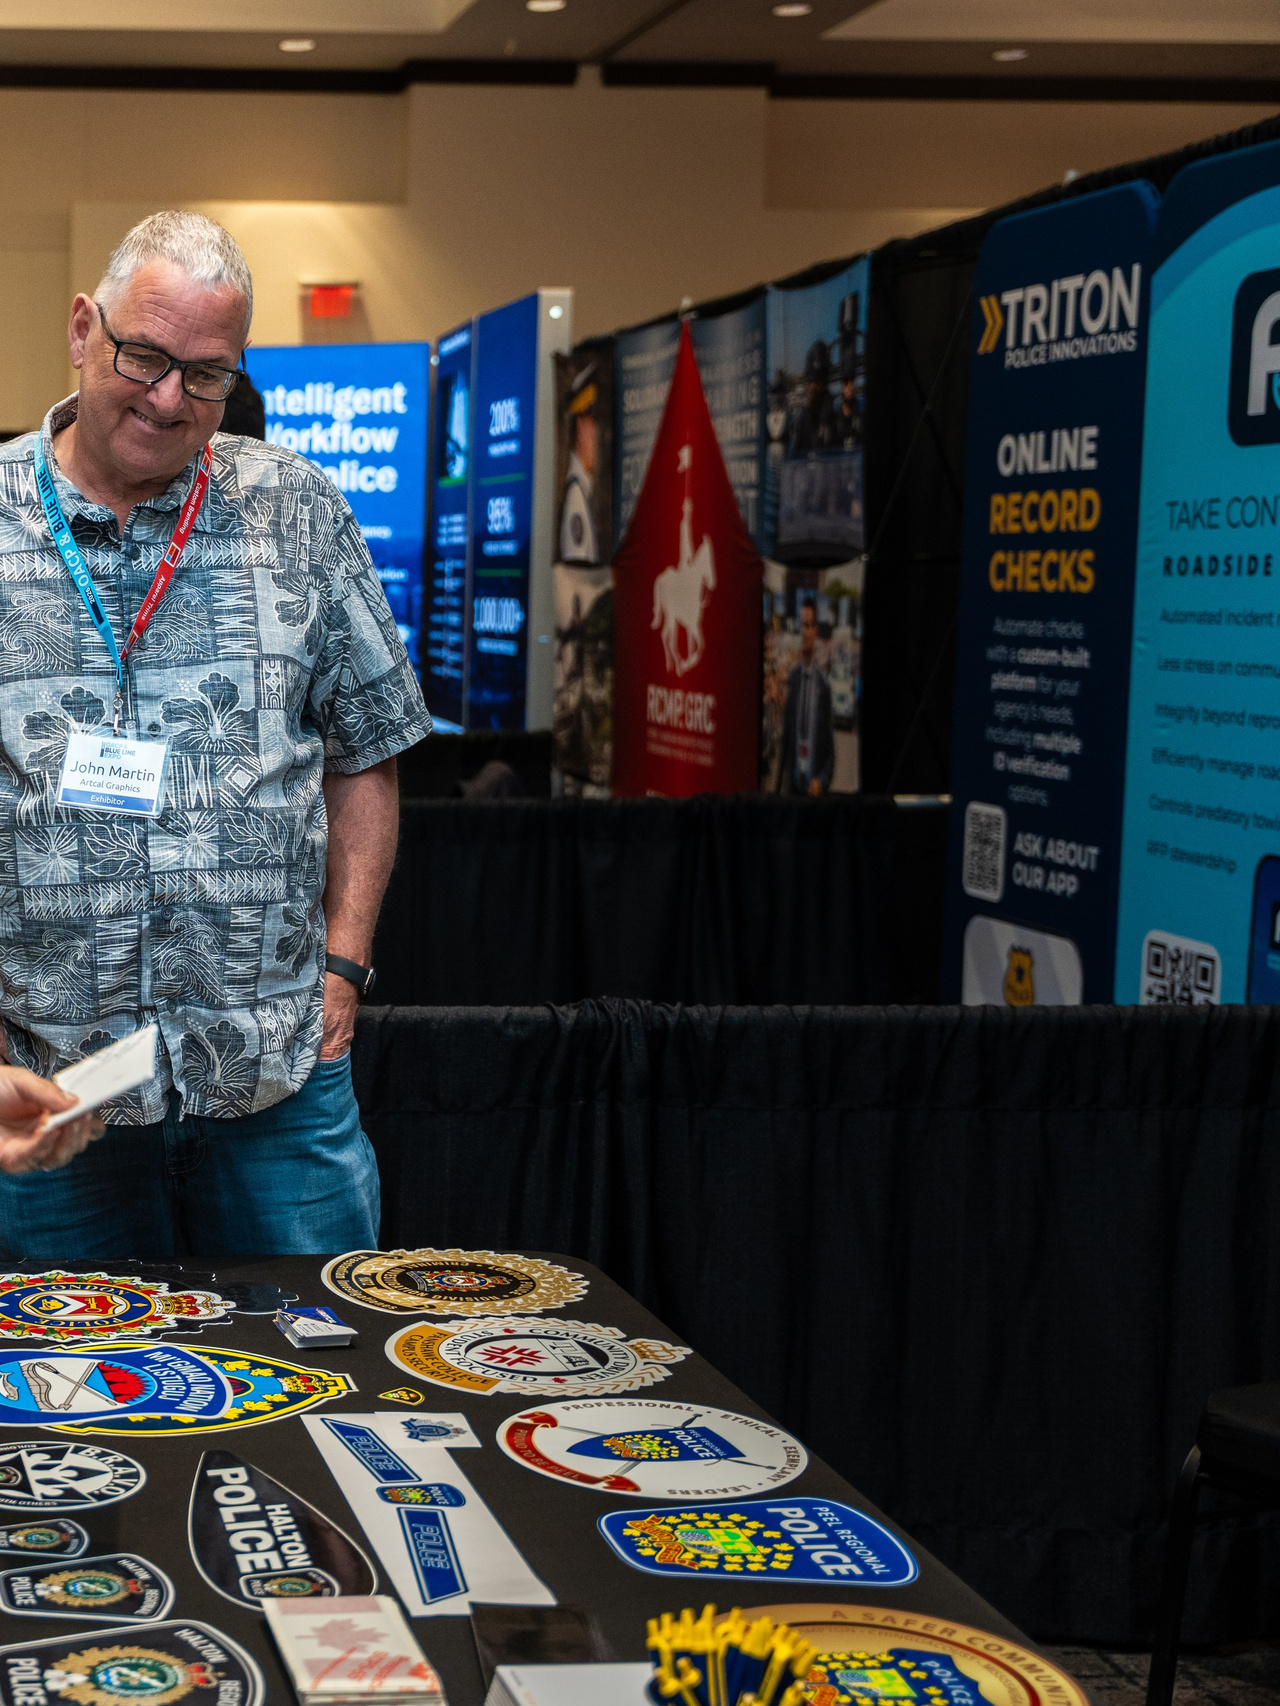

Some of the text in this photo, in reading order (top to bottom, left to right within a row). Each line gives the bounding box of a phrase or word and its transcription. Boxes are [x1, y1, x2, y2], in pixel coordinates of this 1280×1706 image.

[1001, 262, 1141, 349] TRITON
[1004, 330, 1137, 369] POLICE INNOVATIONS
[997, 425, 1099, 478] ONLINE
[38, 469, 53, 500] LINE
[46, 502, 64, 534] BLUE
[179, 482, 202, 535] Custom Branding
[990, 488, 1101, 535] RECORD
[1166, 494, 1280, 531] TAKE CON
[59, 534, 70, 546] &
[65, 550, 89, 587] OACP
[989, 549, 1095, 593] CHECKS
[1163, 554, 1273, 577] ROADSIDE
[141, 575, 165, 621] Apparel Trims
[1161, 607, 1273, 627] Automated incident
[1017, 647, 1090, 668] custom-built
[991, 671, 1036, 692] platform
[1032, 732, 1082, 756] multiple
[70, 761, 155, 781] John Martin
[80, 779, 140, 793] Artcal Graphics
[1008, 755, 1070, 781] verification
[90, 795, 125, 806] Exhibitor
[1013, 831, 1101, 872] ASK ABOUT
[1012, 862, 1079, 898] OUR APP
[36, 1284, 130, 1295] LONDON
[487, 1266, 534, 1295] LONDON POLICE
[34, 1318, 125, 1326] POLICE
[400, 1334, 425, 1357] CAMPUS
[419, 1332, 492, 1384] FANSHAWE COLLEGE
[444, 1331, 540, 1382] STUDENT FOCUSED
[527, 1329, 631, 1381] COMMUNITY DRIVEN
[142, 1363, 188, 1403] LISTUGUJ
[405, 1358, 460, 1382] SECURITY
[181, 1381, 211, 1413] NATION
[345, 1435, 402, 1471] POLICE
[512, 1429, 581, 1480] PROUD TO BE PEEL
[560, 1401, 801, 1495] PROFESSIONAL ETHICAL EXEMPLARY LEADERS
[667, 1430, 716, 1458] POLICE
[77, 1448, 139, 1496] B.R.A.V.O.
[428, 1485, 449, 1505] POLICE
[206, 1467, 283, 1574] POLICE
[265, 1503, 312, 1567] HALTON
[411, 1524, 450, 1569] POLICE
[766, 1507, 864, 1576] POLICE
[811, 1506, 891, 1575] PEEL REGIONAL
[10, 1576, 37, 1606] POLICE
[116, 1559, 160, 1615] HALTON REGIONAL
[249, 1579, 264, 1595] POLICE
[831, 1610, 847, 1619] A
[862, 1613, 958, 1637] SAFER
[173, 1628, 229, 1663] HALTON
[5, 1658, 47, 1706] POLICE
[918, 1660, 974, 1705] POLICE
